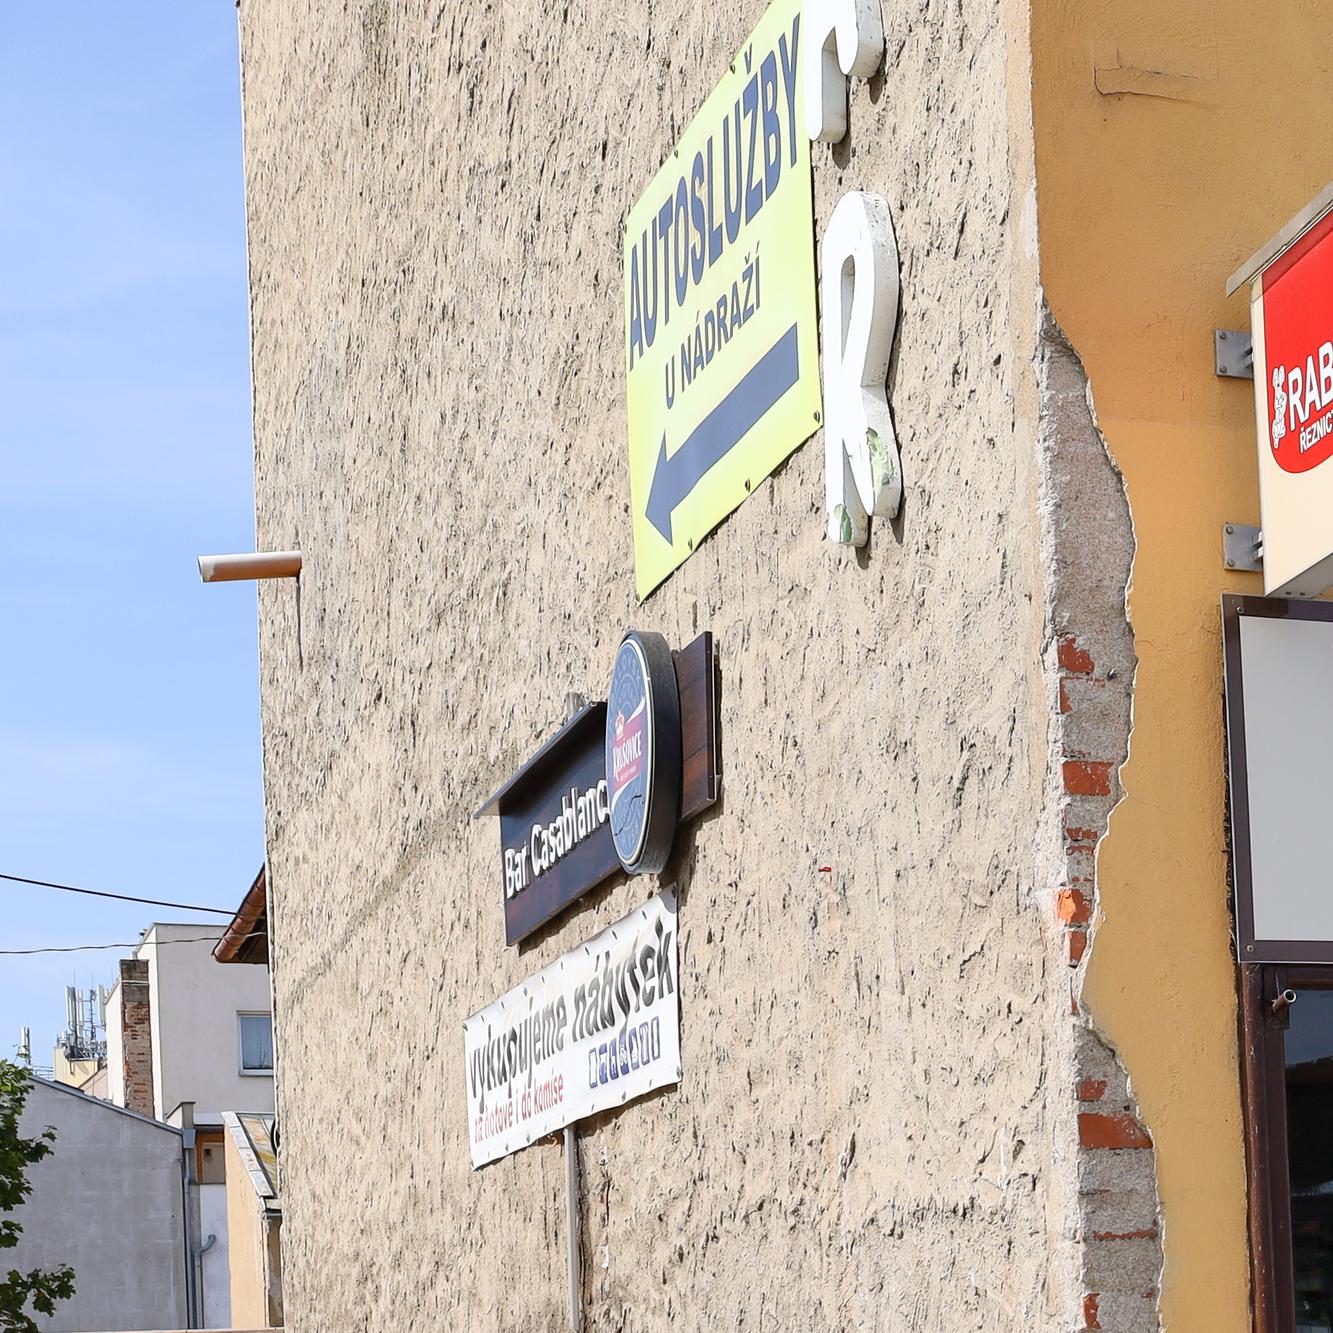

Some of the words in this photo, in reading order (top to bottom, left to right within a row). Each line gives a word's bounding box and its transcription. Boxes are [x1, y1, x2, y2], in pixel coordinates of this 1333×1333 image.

[628, 12, 800, 371] AUTOSLUŽBY
[664, 357, 674, 409] U
[681, 241, 761, 393] NÁDRAŽÍ
[505, 842, 529, 899] Bar
[531, 779, 610, 876] Casablanc
[470, 994, 567, 1114] vykupujeme
[572, 915, 674, 1042] nábytek
[521, 1083, 531, 1121] do
[533, 1070, 564, 1116] komise
